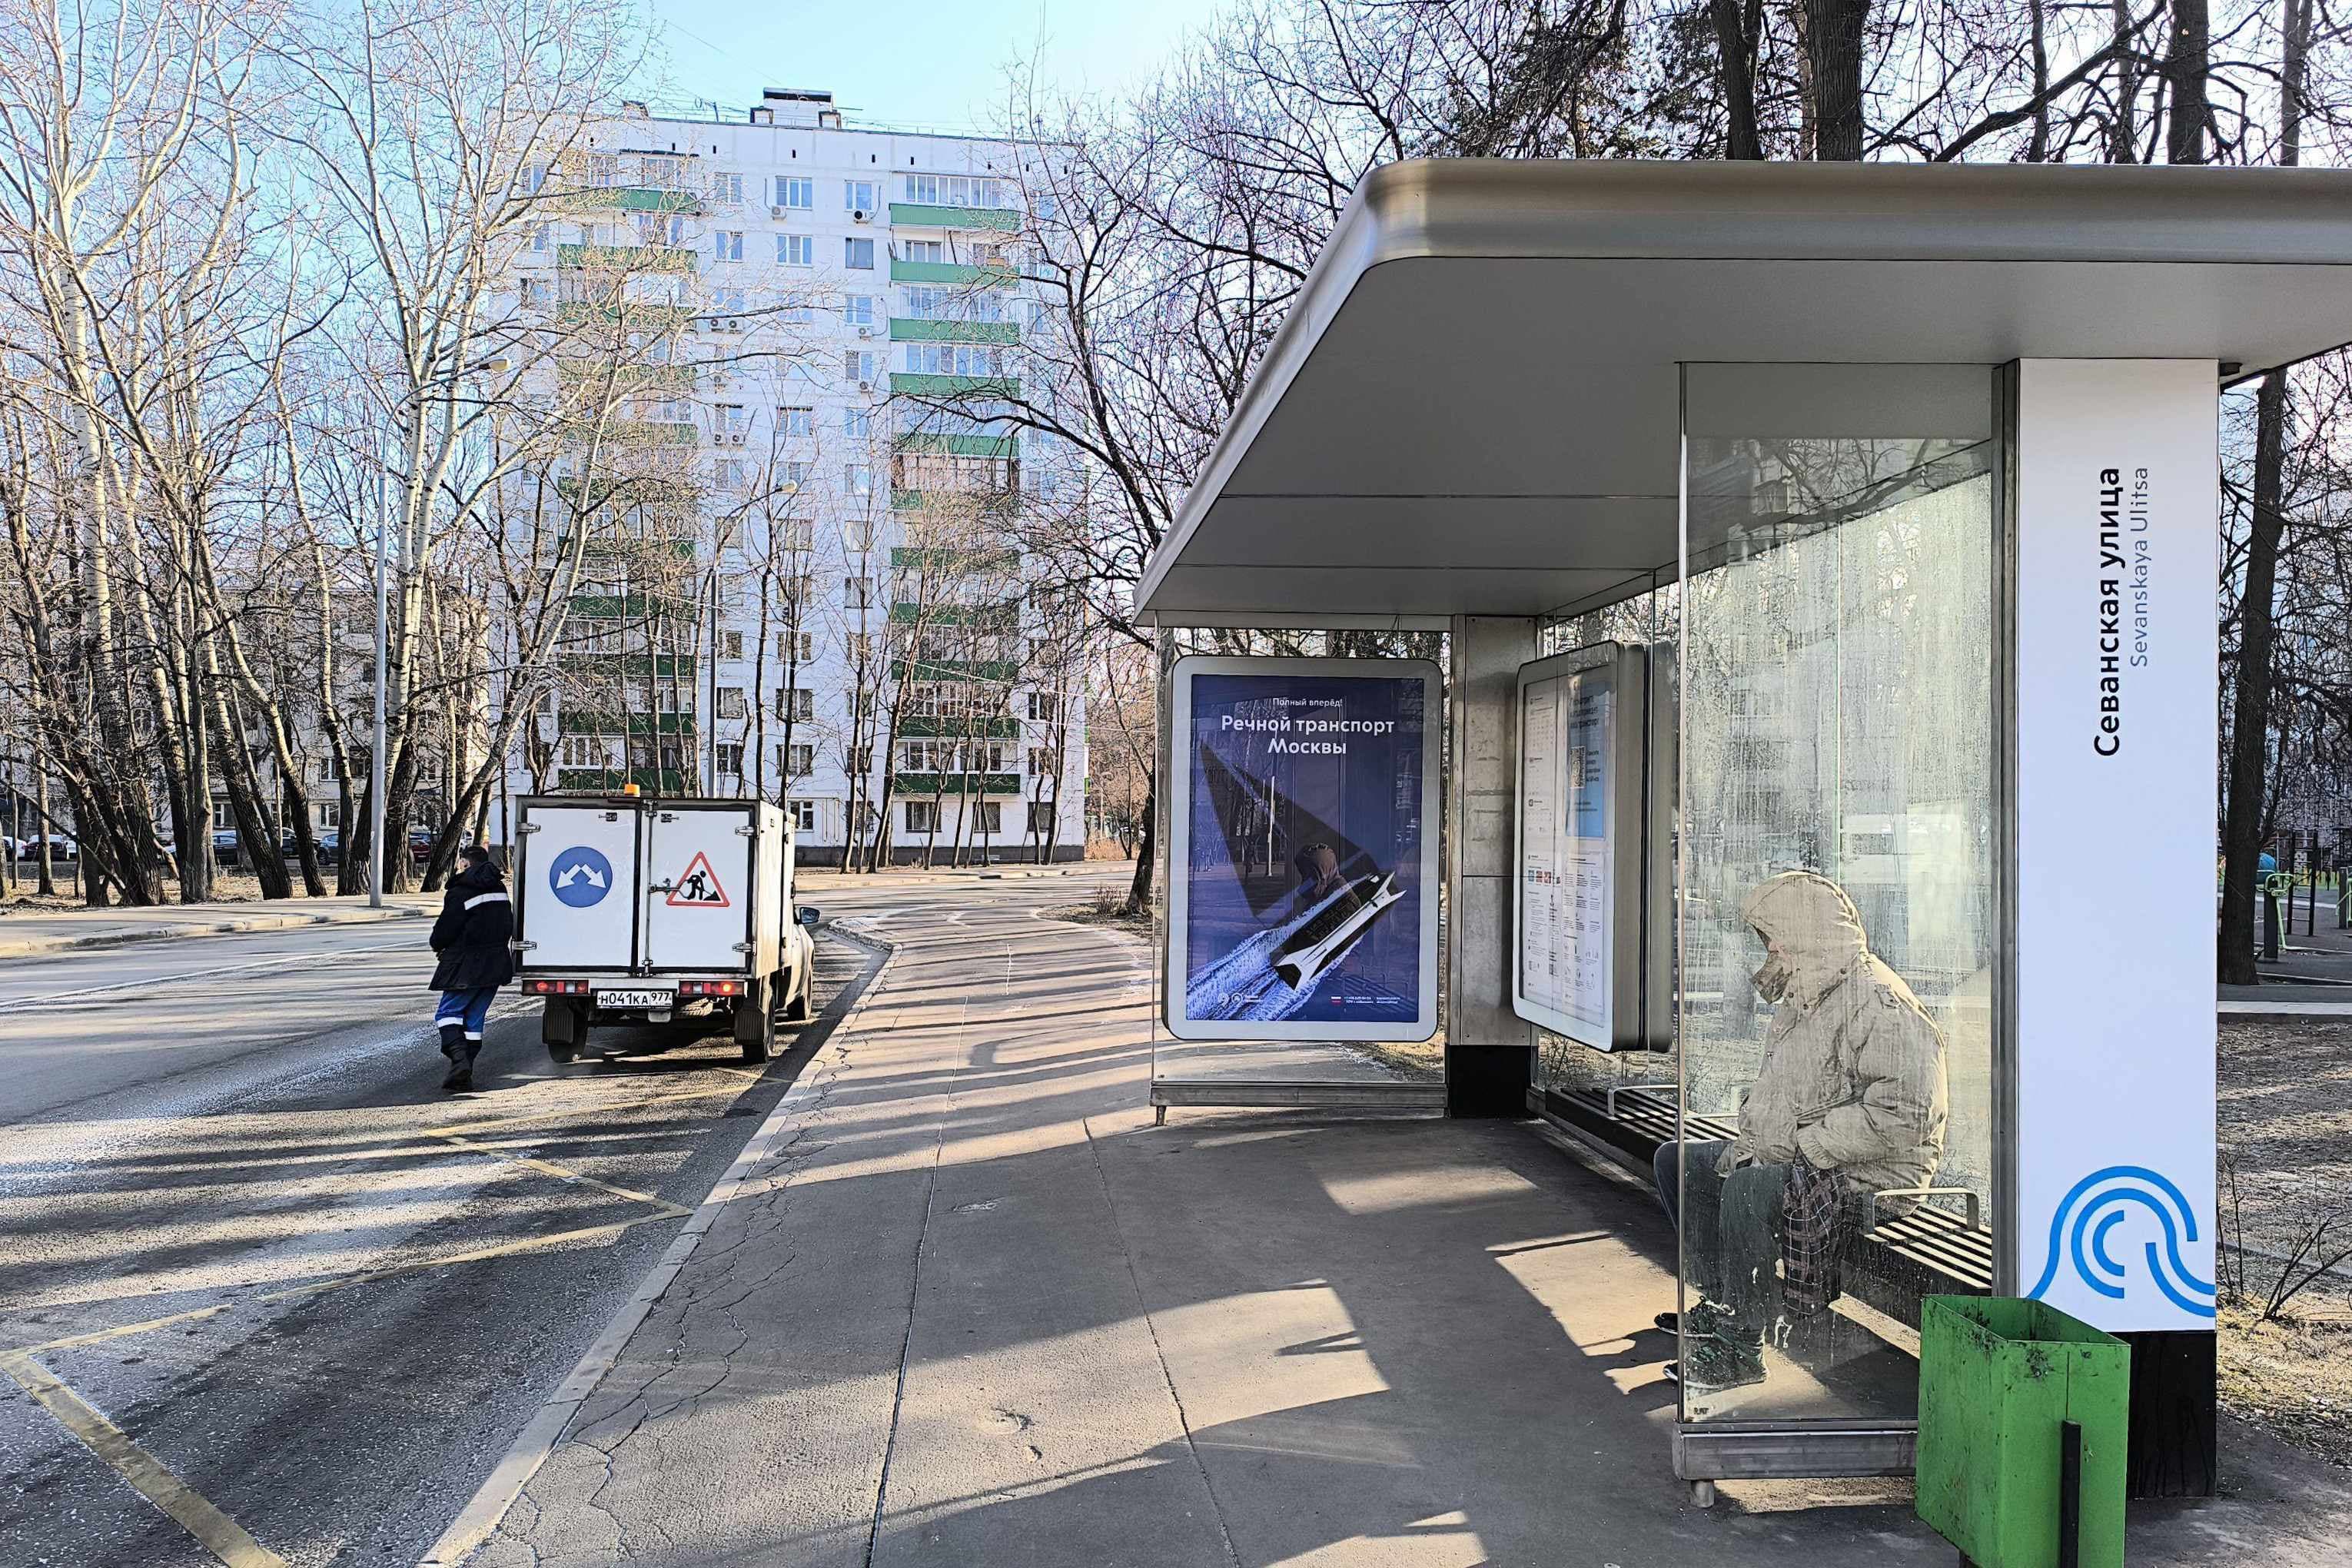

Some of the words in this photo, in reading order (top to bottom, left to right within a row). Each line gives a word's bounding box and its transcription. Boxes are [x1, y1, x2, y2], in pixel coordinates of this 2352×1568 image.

[2100, 468, 2126, 569] улица
[2129, 467, 2148, 532] Ulitsa
[2129, 540, 2152, 667] Sevanskaya
[2093, 579, 2121, 756] Севанская
[1272, 697, 1307, 707] Полный
[1309, 698, 1344, 708] вперёд!
[1221, 715, 1291, 732] Речной
[1295, 719, 1395, 736] транспорт
[1267, 737, 1347, 754] Москвы
[601, 992, 649, 1005] Н041КА
[651, 992, 669, 1002] 977
